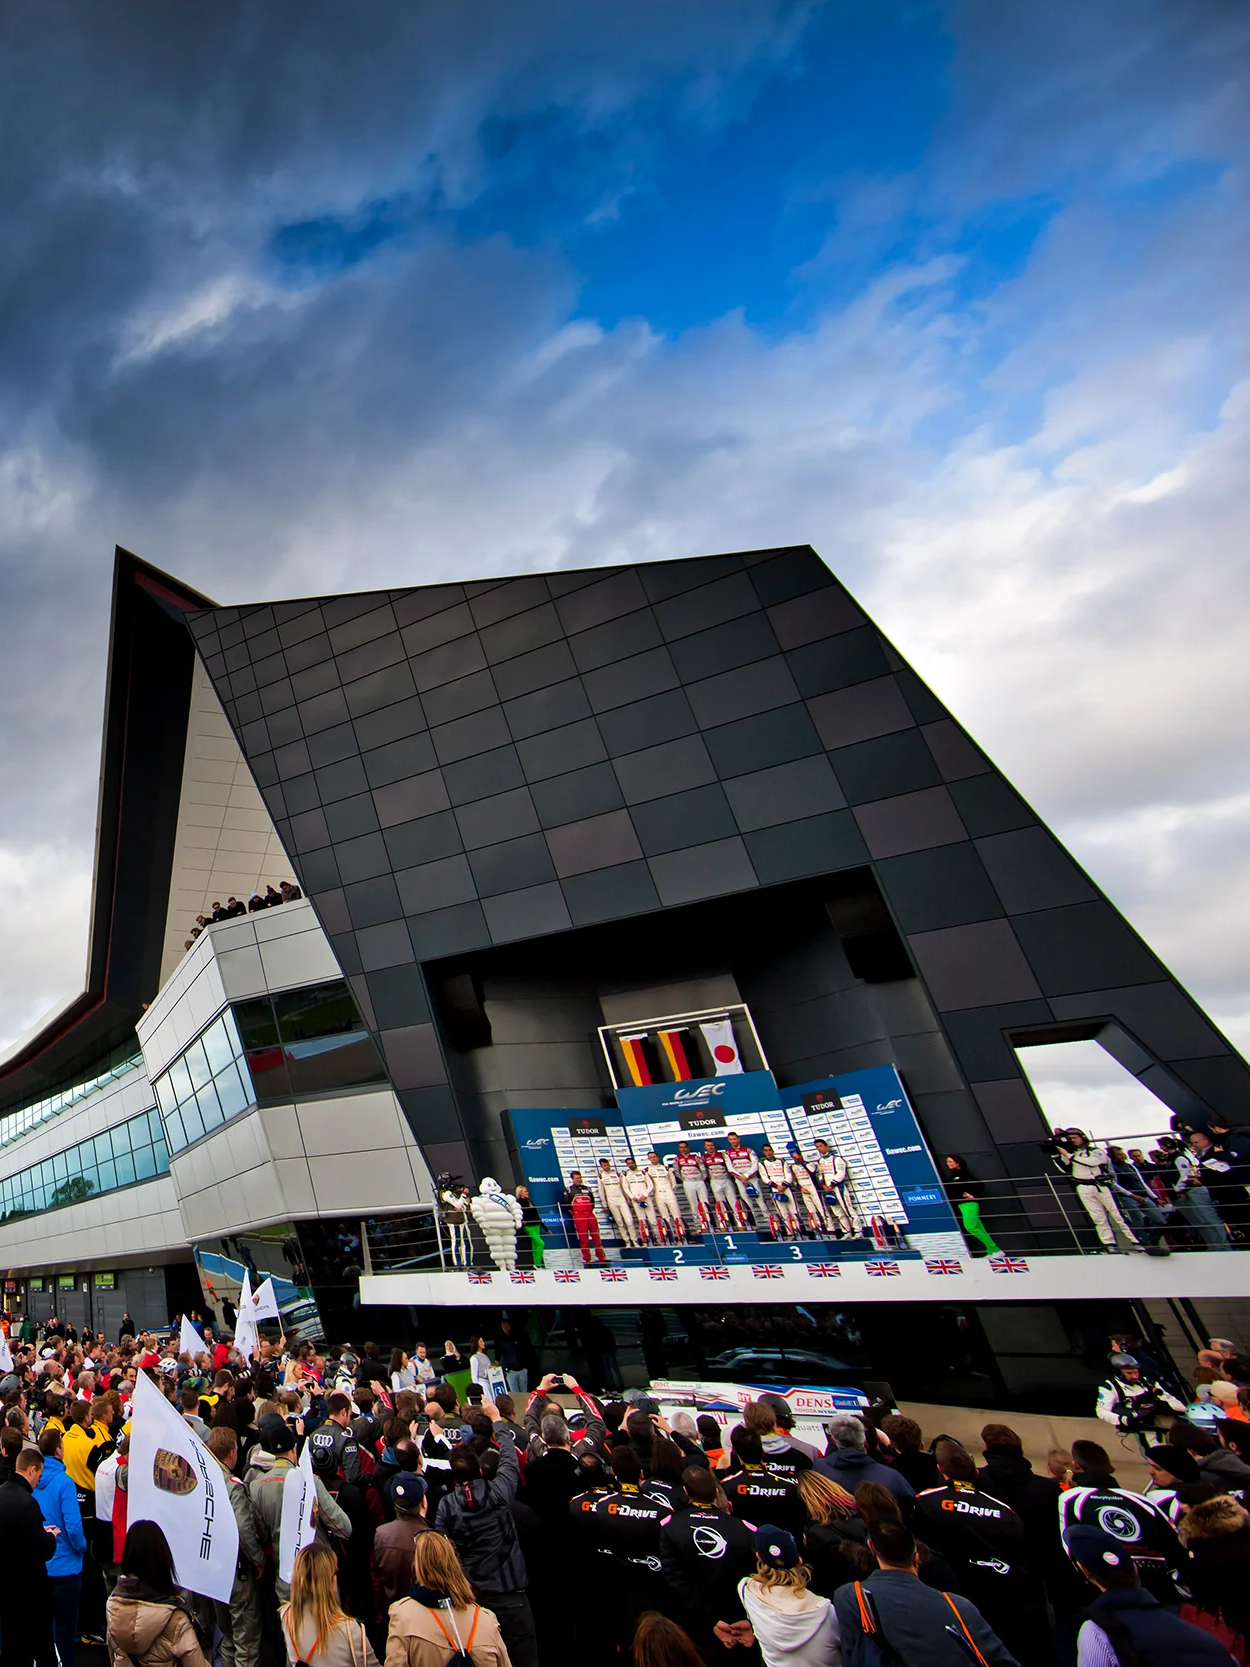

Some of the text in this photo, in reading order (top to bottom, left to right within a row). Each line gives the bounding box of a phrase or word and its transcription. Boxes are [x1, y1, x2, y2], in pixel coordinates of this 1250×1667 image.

[811, 1101, 835, 1112] TUDOR
[688, 1118, 717, 1127] TUDOR
[688, 1130, 726, 1138] fiawec.com
[885, 1145, 922, 1155] fiawec.com
[908, 1194, 937, 1202] POMMERY
[724, 1235, 738, 1250] 1
[672, 1249, 685, 1264] 2
[789, 1245, 803, 1260] 3
